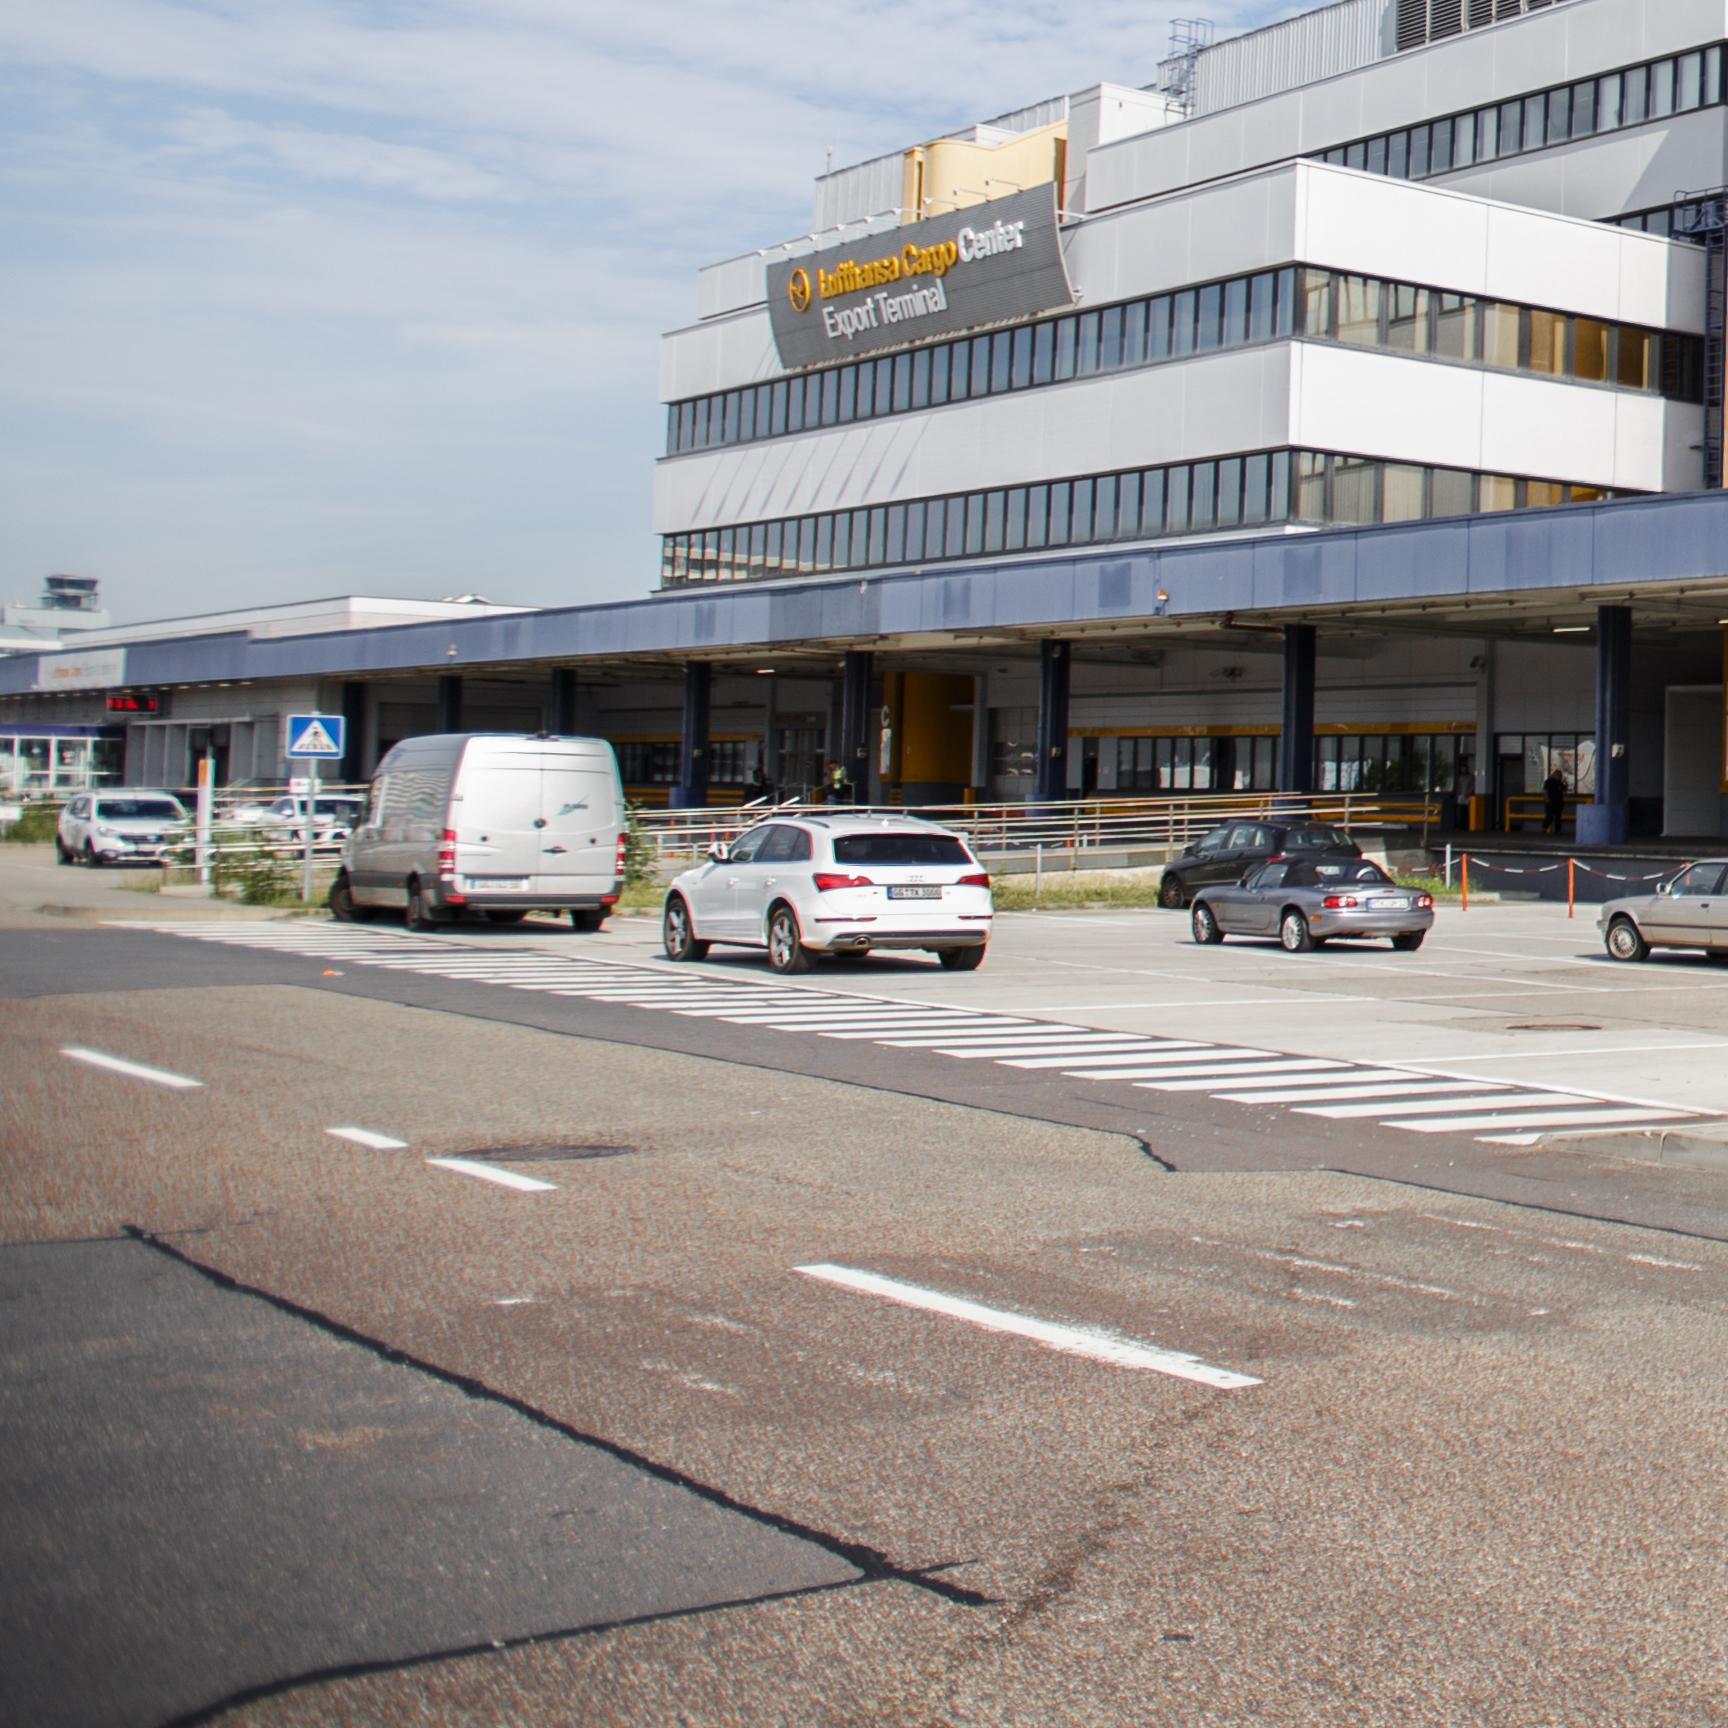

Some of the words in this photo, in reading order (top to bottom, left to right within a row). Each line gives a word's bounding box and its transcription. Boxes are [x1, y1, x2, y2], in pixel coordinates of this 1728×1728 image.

[818, 253, 899, 298] Lufthansa
[899, 239, 957, 277] Cargo
[958, 219, 1025, 263] Center
[822, 296, 878, 340] Export
[875, 278, 949, 325] Terminal
